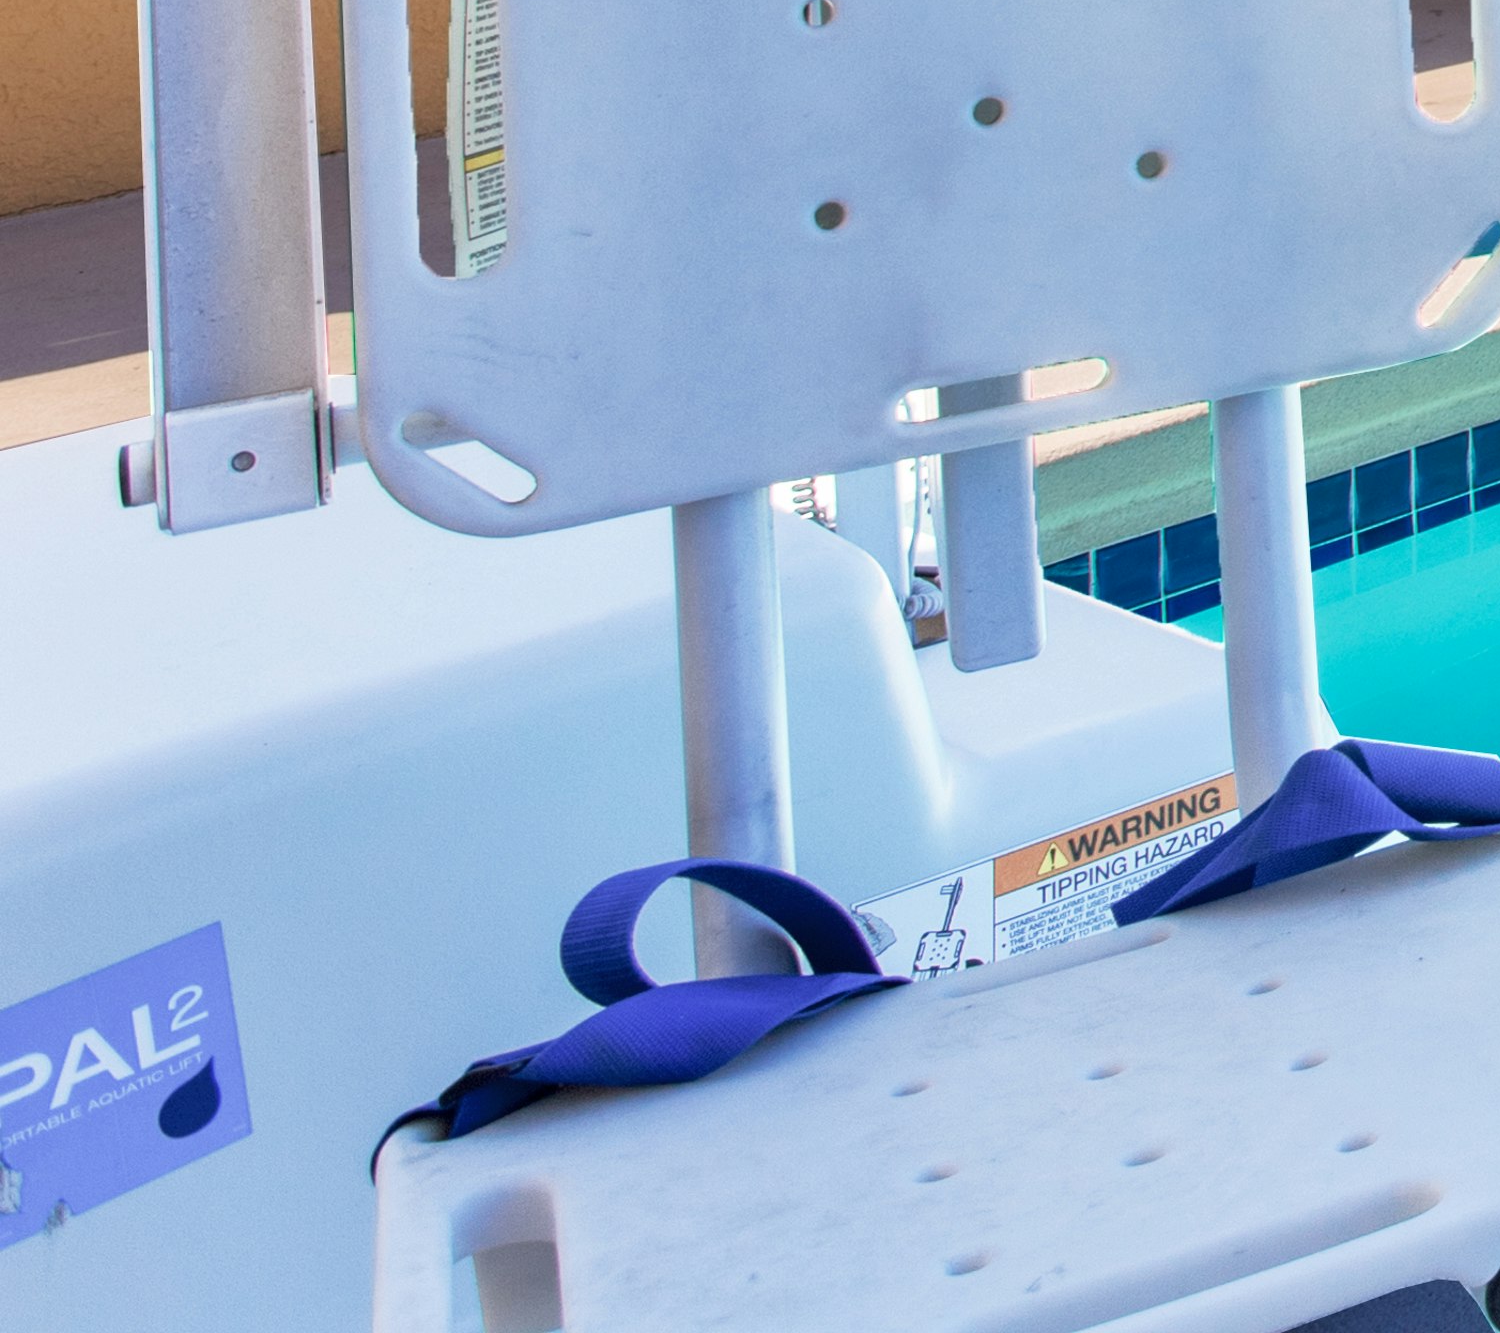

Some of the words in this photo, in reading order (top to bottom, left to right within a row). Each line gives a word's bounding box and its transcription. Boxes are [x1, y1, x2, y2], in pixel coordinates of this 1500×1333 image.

[1067, 787, 1221, 862] WARNING
[1037, 857, 1127, 903] TIPPING
[1135, 821, 1224, 868] HAZARD
[1009, 927, 1026, 938] USE
[1028, 920, 1047, 931] AND
[1048, 910, 1071, 924] MUST
[1073, 906, 1083, 915] BE
[1086, 896, 1109, 909] USED
[1110, 891, 1119, 900] AT
[1061, 897, 1085, 910] ARMS
[1087, 886, 1110, 900] MUST
[1112, 882, 1123, 892] BE
[1125, 873, 1148, 886] FULLY
[1009, 941, 1034, 955] ARMS
[1036, 931, 1061, 944] FULLY
[1010, 936, 1025, 946] THE
[1028, 928, 1045, 940] LIFT
[1047, 921, 1065, 932] MAY
[1067, 914, 1083, 925] NOT
[1085, 909, 1096, 918] BE
[0, 1105, 82, 1150] ORTABLE
[87, 1070, 164, 1112] AQUATIC
[168, 1051, 204, 1076] LIFT
